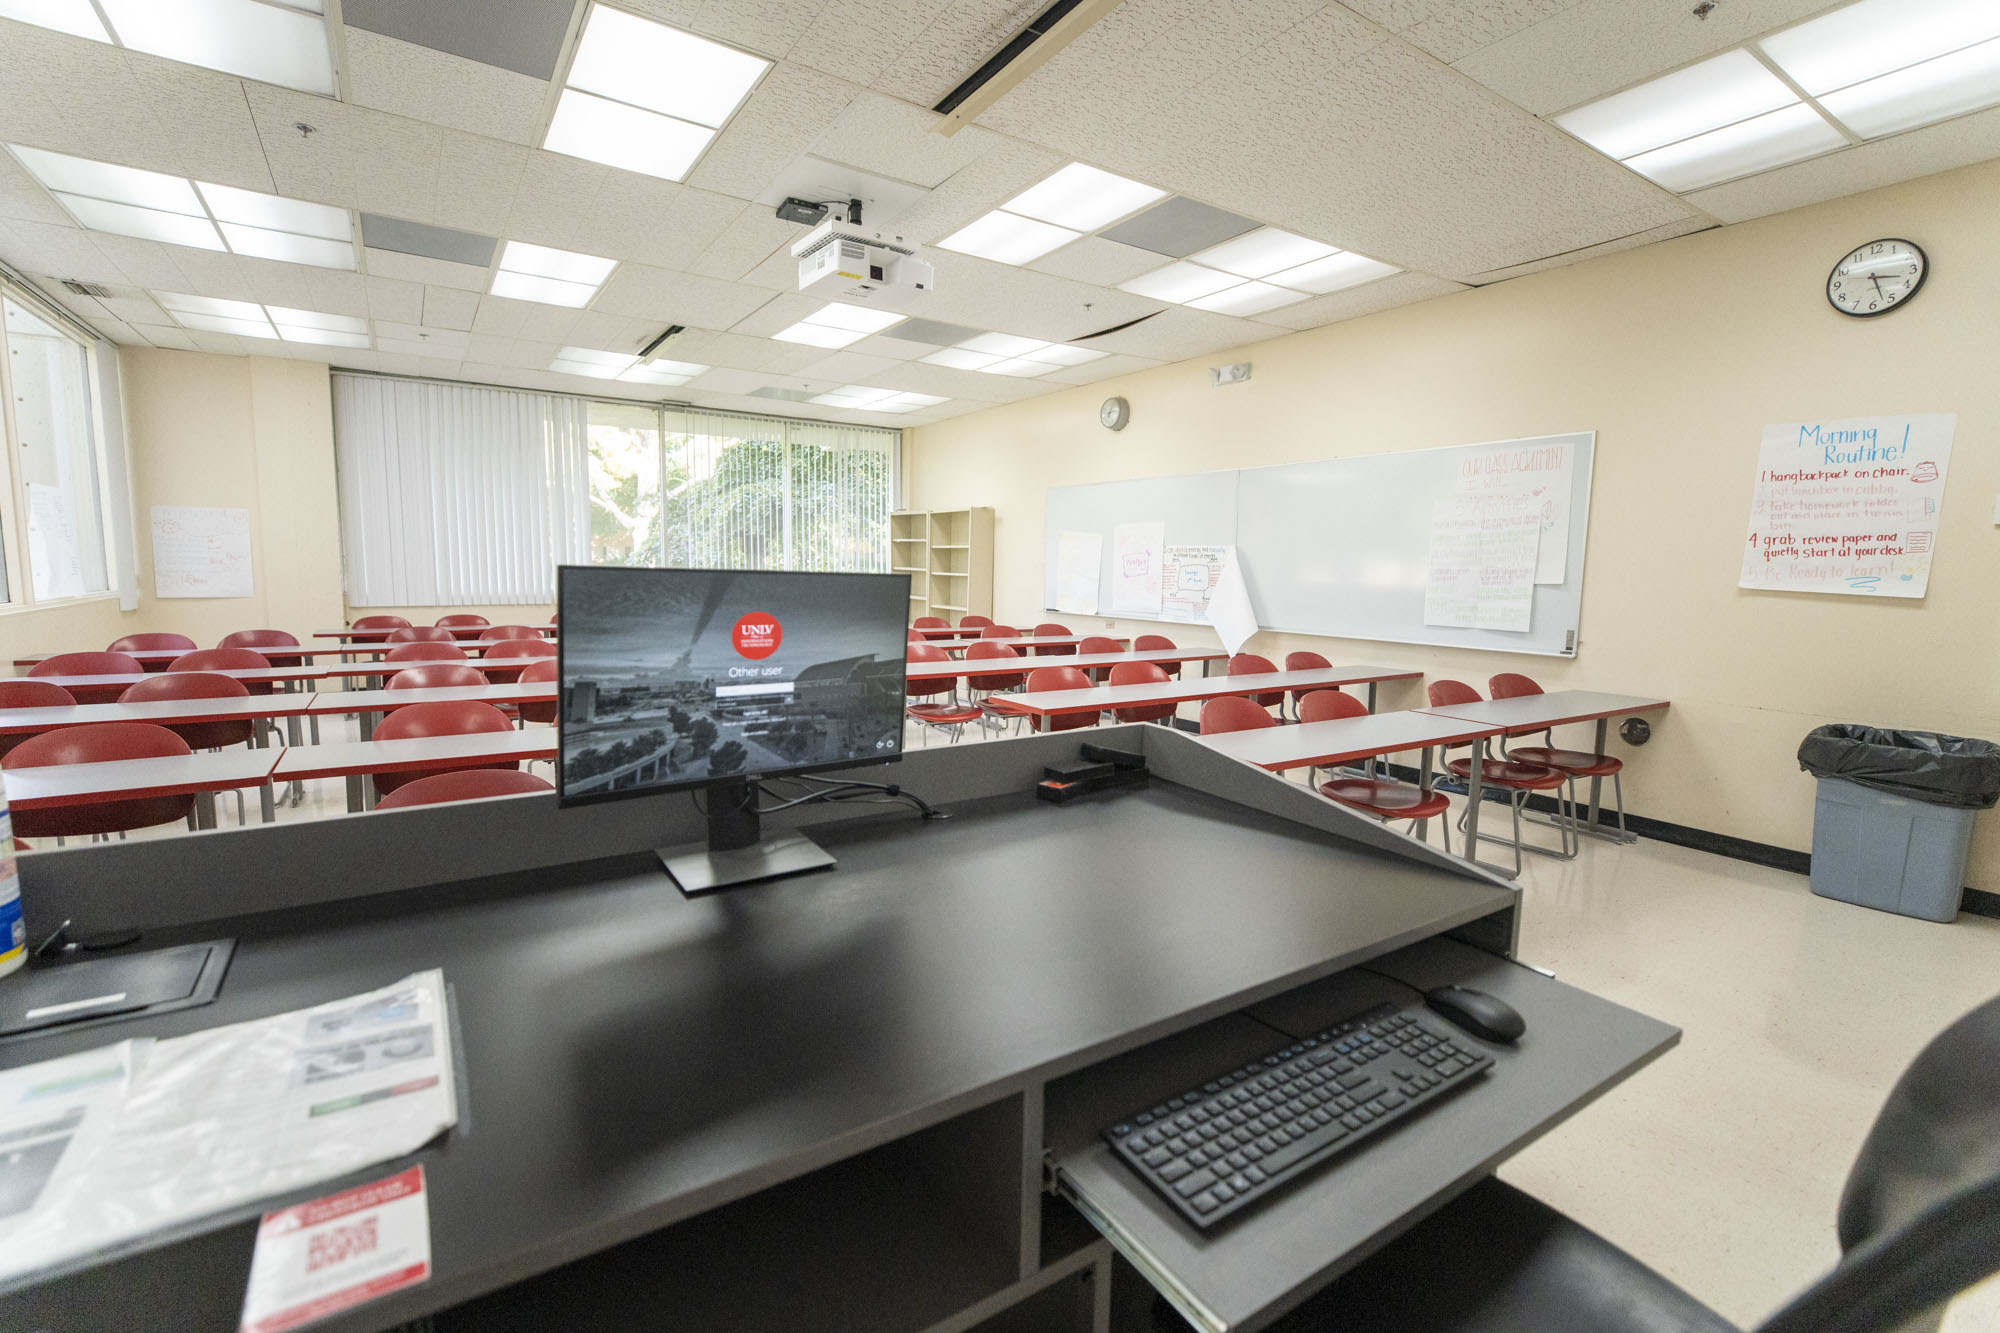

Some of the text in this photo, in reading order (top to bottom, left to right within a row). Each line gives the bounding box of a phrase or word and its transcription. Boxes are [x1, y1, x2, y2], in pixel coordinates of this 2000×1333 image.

[1870, 244, 1884, 254] 12
[1854, 253, 1863, 263] 11
[1838, 266, 1850, 276] 10
[1909, 264, 1918, 274] 3
[1833, 280, 1842, 291] 9
[1903, 279, 1911, 289] 4
[1838, 292, 1846, 302] 8
[1887, 293, 1895, 304] 5
[1852, 299, 1860, 311] 7
[1869, 300, 1878, 310] 6
[1798, 424, 1878, 449] Morning
[1854, 468, 1870, 478] on
[1872, 466, 1910, 478] chair.
[1749, 532, 1898, 550] 4 grab review paper and
[1763, 546, 1799, 562] quietly
[1802, 546, 1836, 558] start
[1838, 546, 1851, 558] at
[1855, 548, 1880, 560] your
[741, 624, 774, 636] UNLV
[728, 666, 784, 678] Other user
